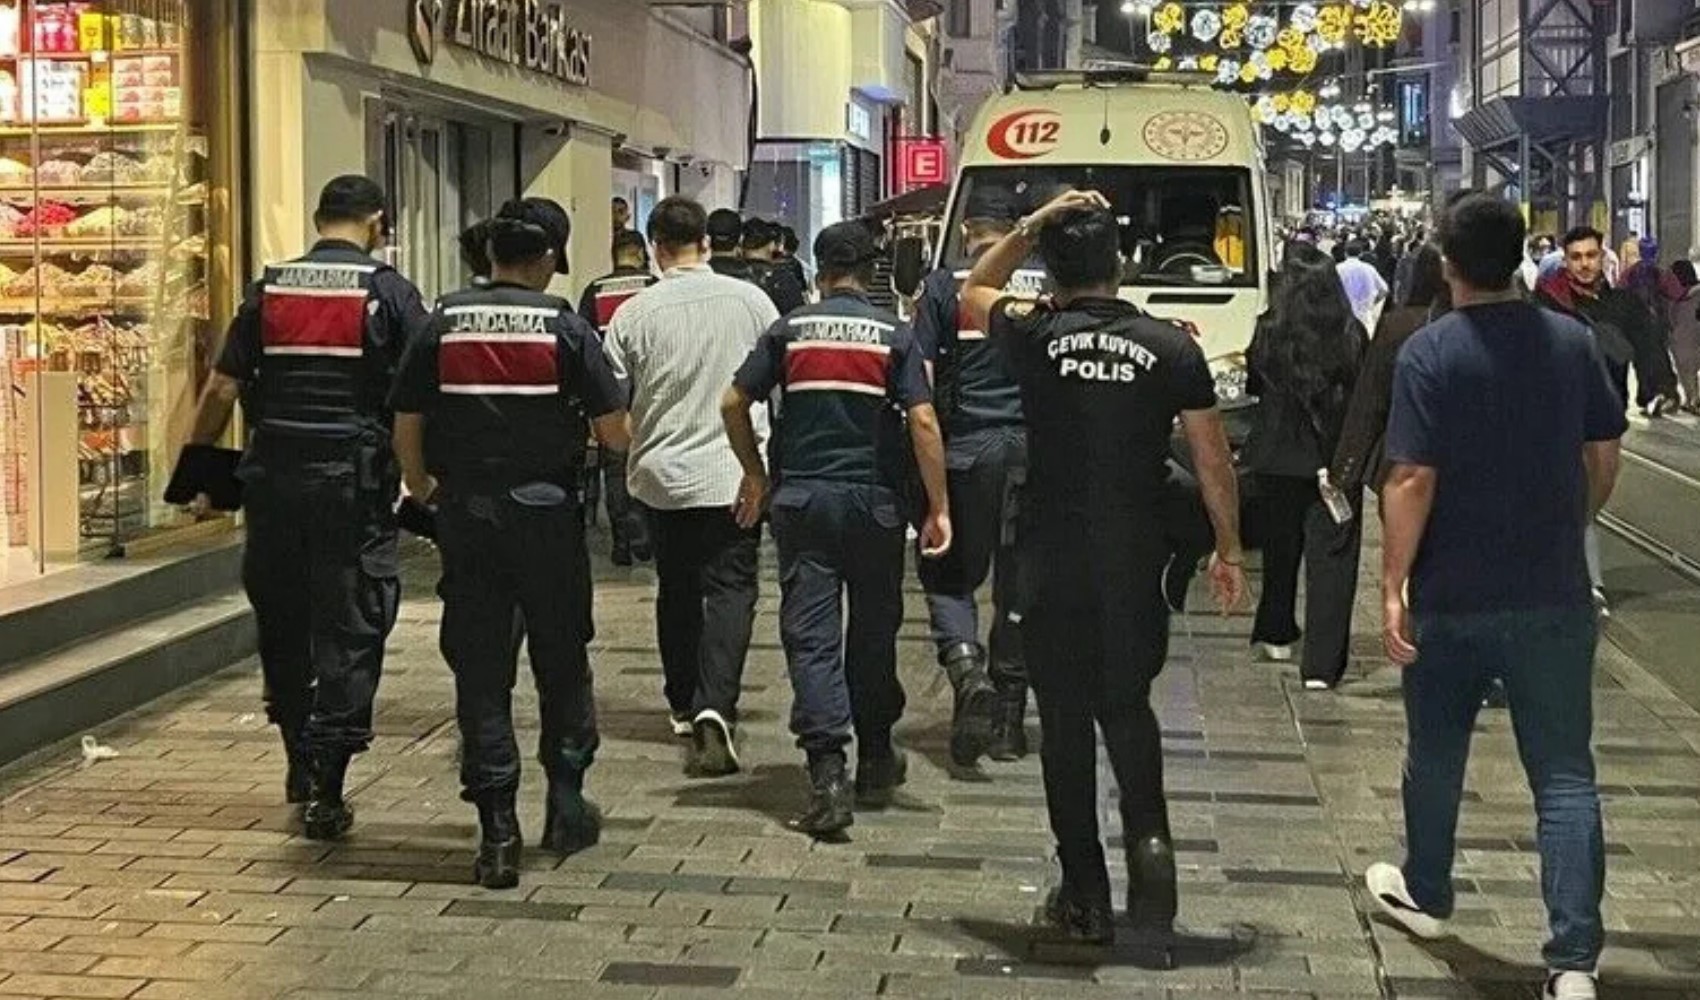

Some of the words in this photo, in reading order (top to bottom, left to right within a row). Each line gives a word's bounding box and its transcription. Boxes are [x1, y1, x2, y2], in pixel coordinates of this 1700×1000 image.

[1014, 121, 1061, 144] 112
[915, 151, 937, 176] E
[276, 267, 360, 288] JANDARMA
[451, 312, 546, 334] JANDARMA
[797, 321, 880, 345] JANDARMA
[1098, 333, 1158, 371] KUVVET
